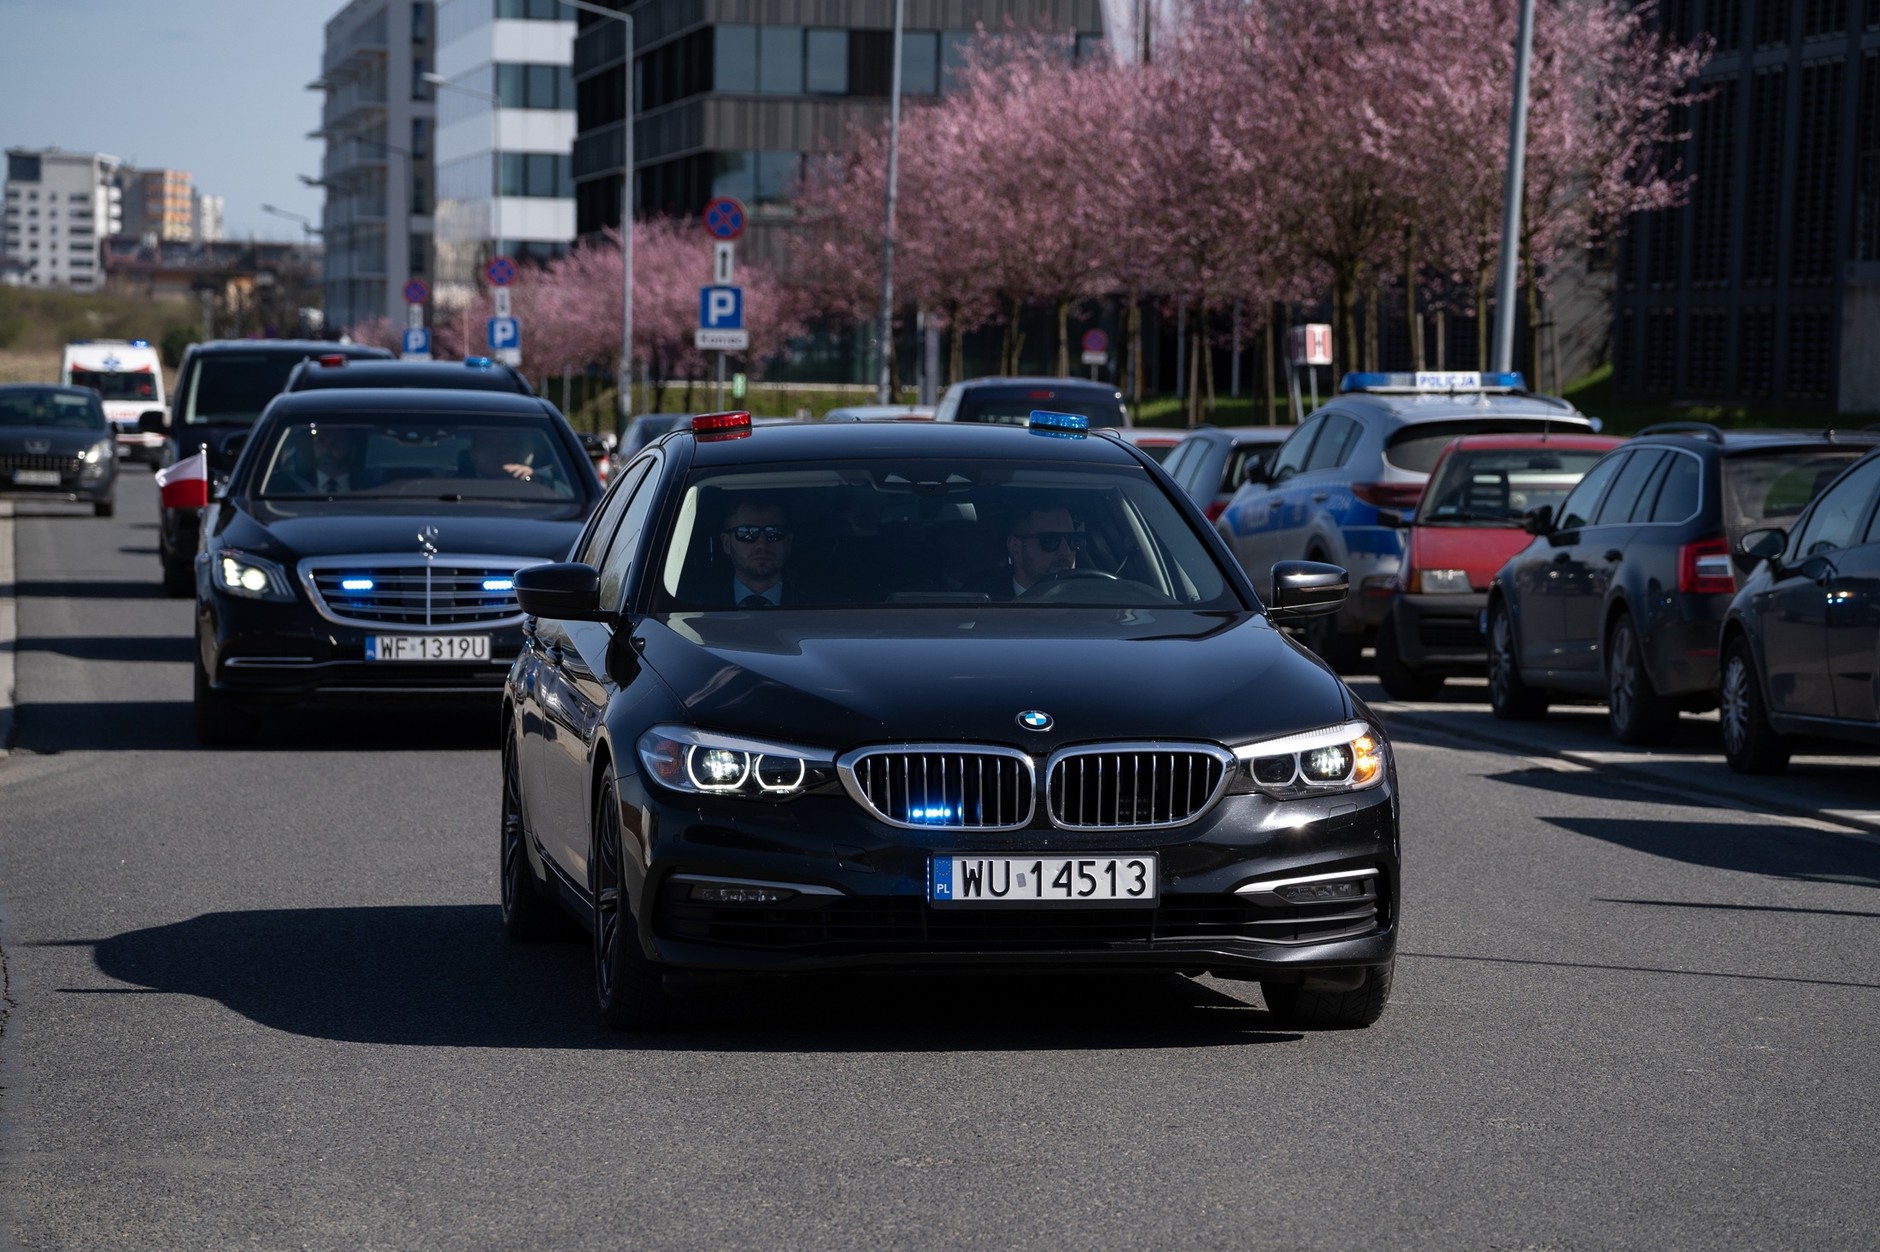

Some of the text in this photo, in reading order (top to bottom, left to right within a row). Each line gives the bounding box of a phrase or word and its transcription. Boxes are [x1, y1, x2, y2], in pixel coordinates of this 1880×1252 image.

[708, 290, 736, 326] P
[493, 319, 515, 349] P
[1419, 375, 1476, 388] POLICJA
[381, 637, 408, 658] WF
[420, 637, 485, 658] 1319U
[936, 883, 950, 894] PL
[961, 860, 1147, 898] WU 14513
